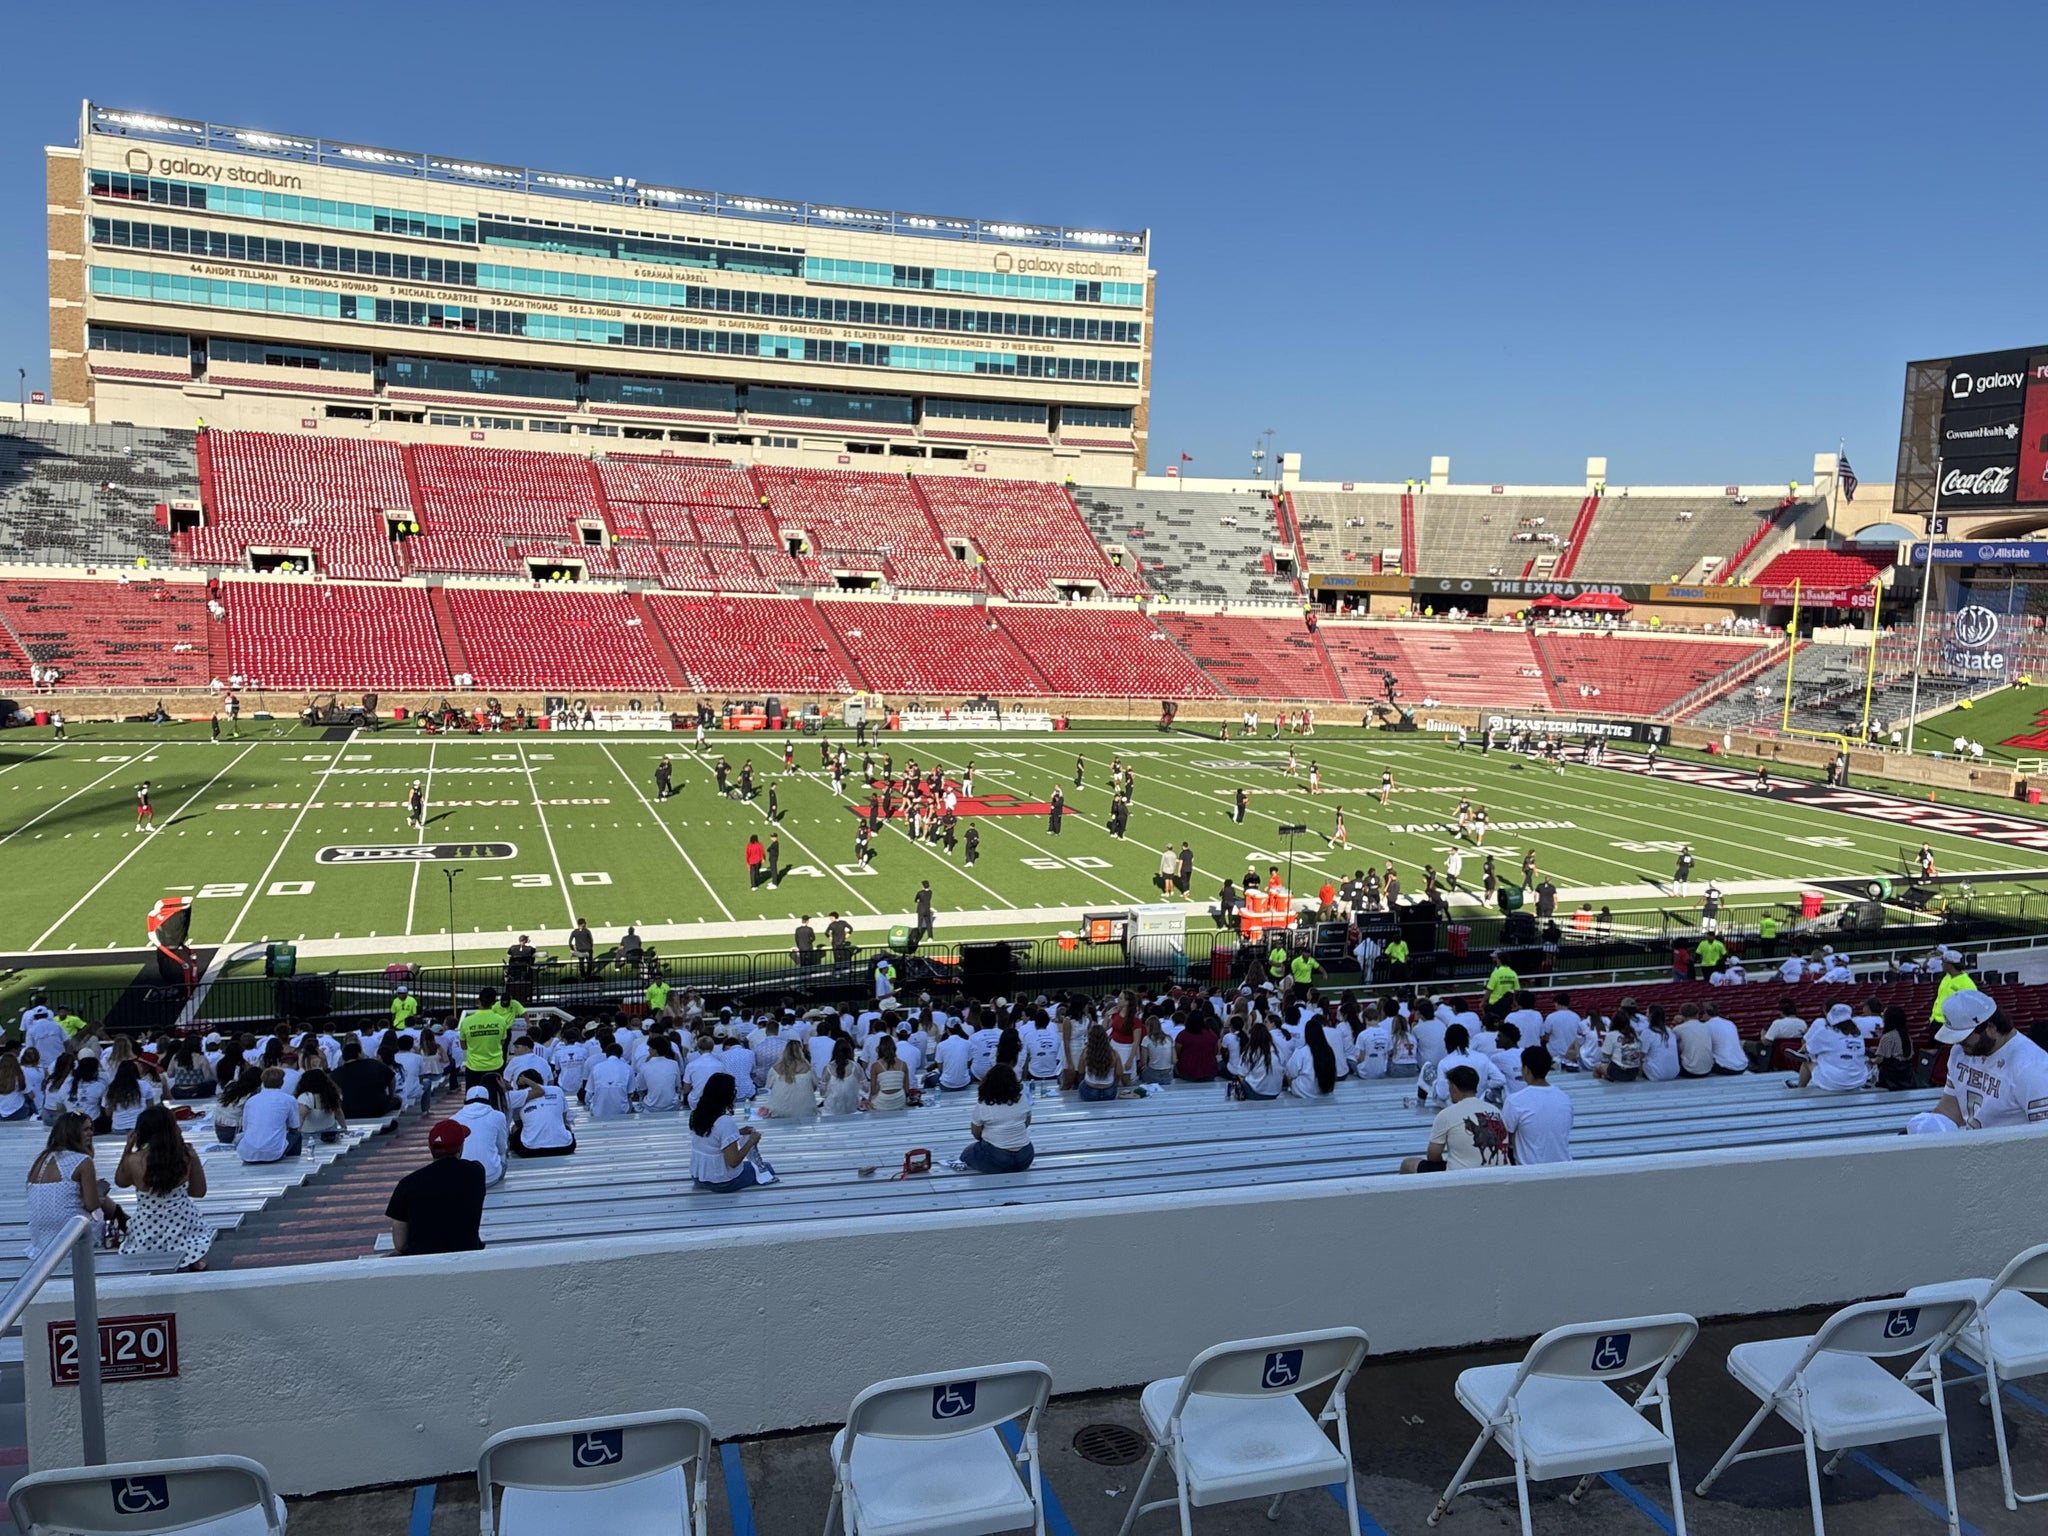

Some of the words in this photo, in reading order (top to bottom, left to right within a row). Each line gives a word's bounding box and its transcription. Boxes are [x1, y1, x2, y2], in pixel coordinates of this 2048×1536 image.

[159, 156, 222, 182] galaxy
[227, 166, 301, 190] stadium
[190, 264, 202, 273] 44
[205, 266, 235, 277] ANDRE
[239, 269, 278, 281] TILLMAN
[1018, 257, 1063, 275] galaxy
[1066, 260, 1121, 276] stadium
[289, 275, 300, 284] 52
[303, 277, 339, 289] THOMAS
[341, 281, 378, 293] HOWARD
[641, 270, 673, 280] GRAHAM
[675, 273, 709, 284] HARRELL
[390, 286, 396, 295] 5
[398, 287, 435, 299] MICHAEL
[437, 291, 478, 304] CRABTREE
[491, 297, 501, 306] 35
[503, 299, 525, 309] ZACH
[526, 301, 558, 312] THOMAS
[596, 308, 621, 318] HOLUB
[632, 311, 641, 320] 44
[643, 312, 668, 322] DONNY
[670, 315, 708, 326] ANDERSON
[728, 320, 746, 330] DAVE
[747, 322, 770, 331] PARKS
[808, 327, 833, 336] RIVERA
[921, 336, 948, 346] PATRICK
[950, 338, 984, 348] MAHOMES
[1028, 344, 1055, 353] WELKER
[1976, 372, 2024, 393] galaxy
[1930, 548, 1963, 559] Allstate
[1995, 548, 2030, 559] Allstate
[1491, 582, 1520, 593] THE
[1524, 583, 1575, 595] EXTRA
[1580, 585, 1623, 596] YARD
[787, 864, 879, 877] 40
[1020, 857, 1113, 870] 50
[510, 872, 612, 887] 30
[196, 881, 315, 898] 20
[59, 1334, 106, 1365] 2
[115, 1327, 165, 1361] 20
